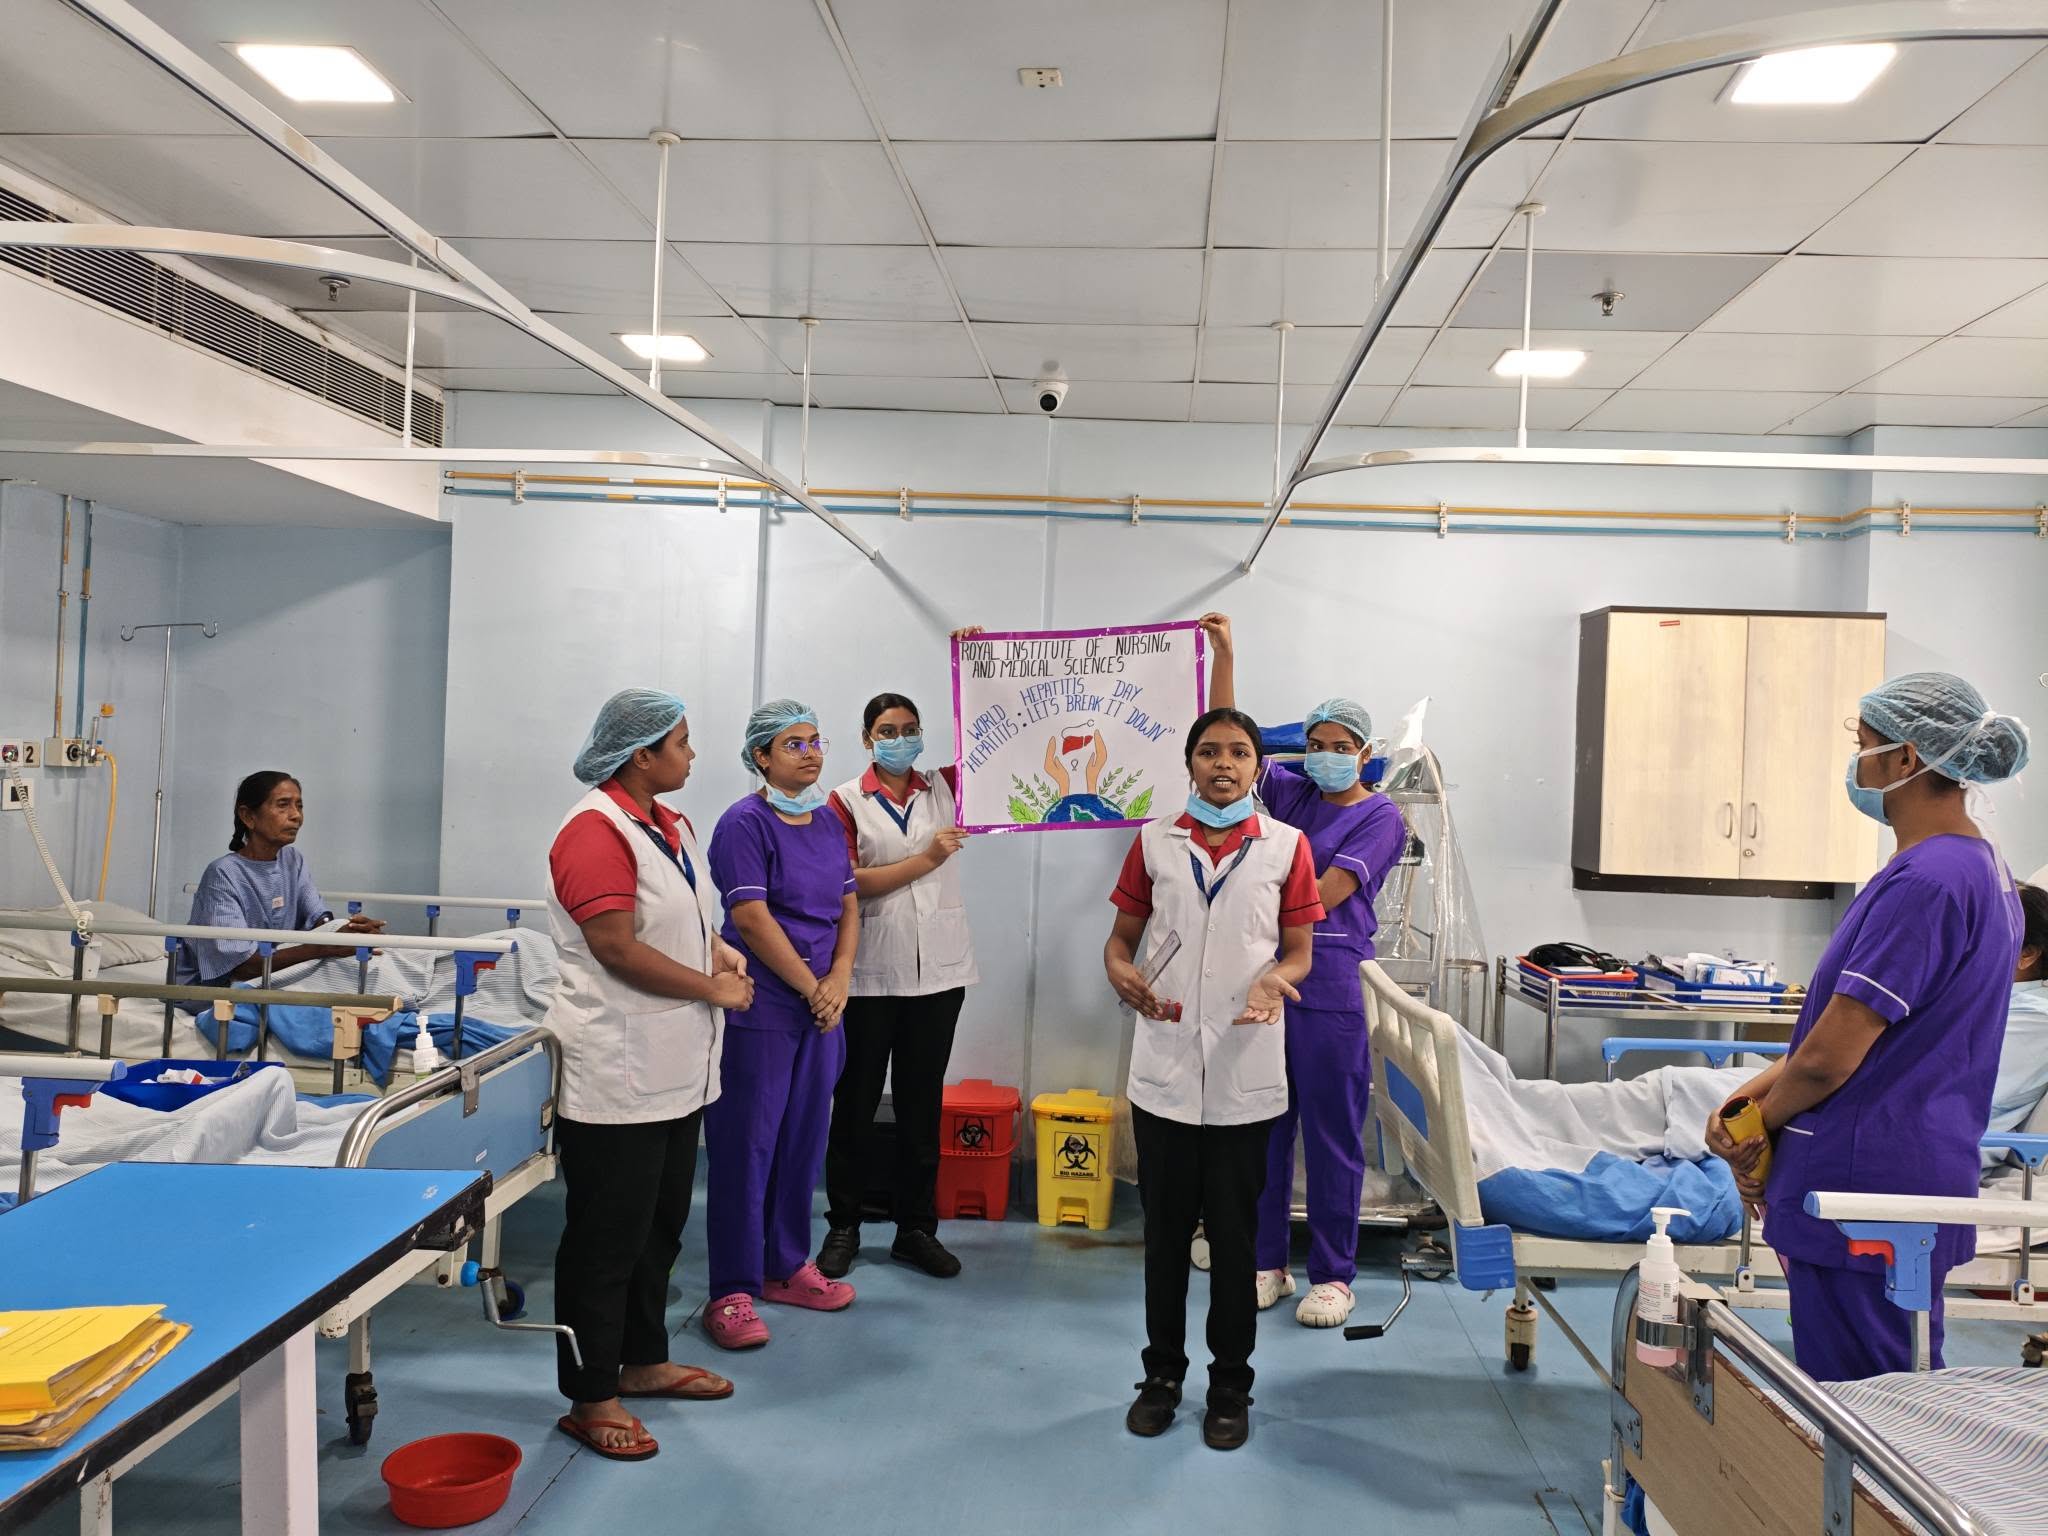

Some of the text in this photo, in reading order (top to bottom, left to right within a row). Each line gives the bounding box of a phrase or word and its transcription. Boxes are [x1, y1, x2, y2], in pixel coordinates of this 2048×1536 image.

[960, 633, 1170, 661] ROYAL INSTITUTE OF NURSING
[972, 656, 1125, 678] AND MEDICAL SCIENCES
[967, 676, 1143, 741] WORLD HEPATITIS DAY
[1027, 697, 1060, 723] LET'S
[1065, 694, 1104, 712] BREAK
[1104, 699, 1125, 718] IT
[25, 745, 34, 763] 2
